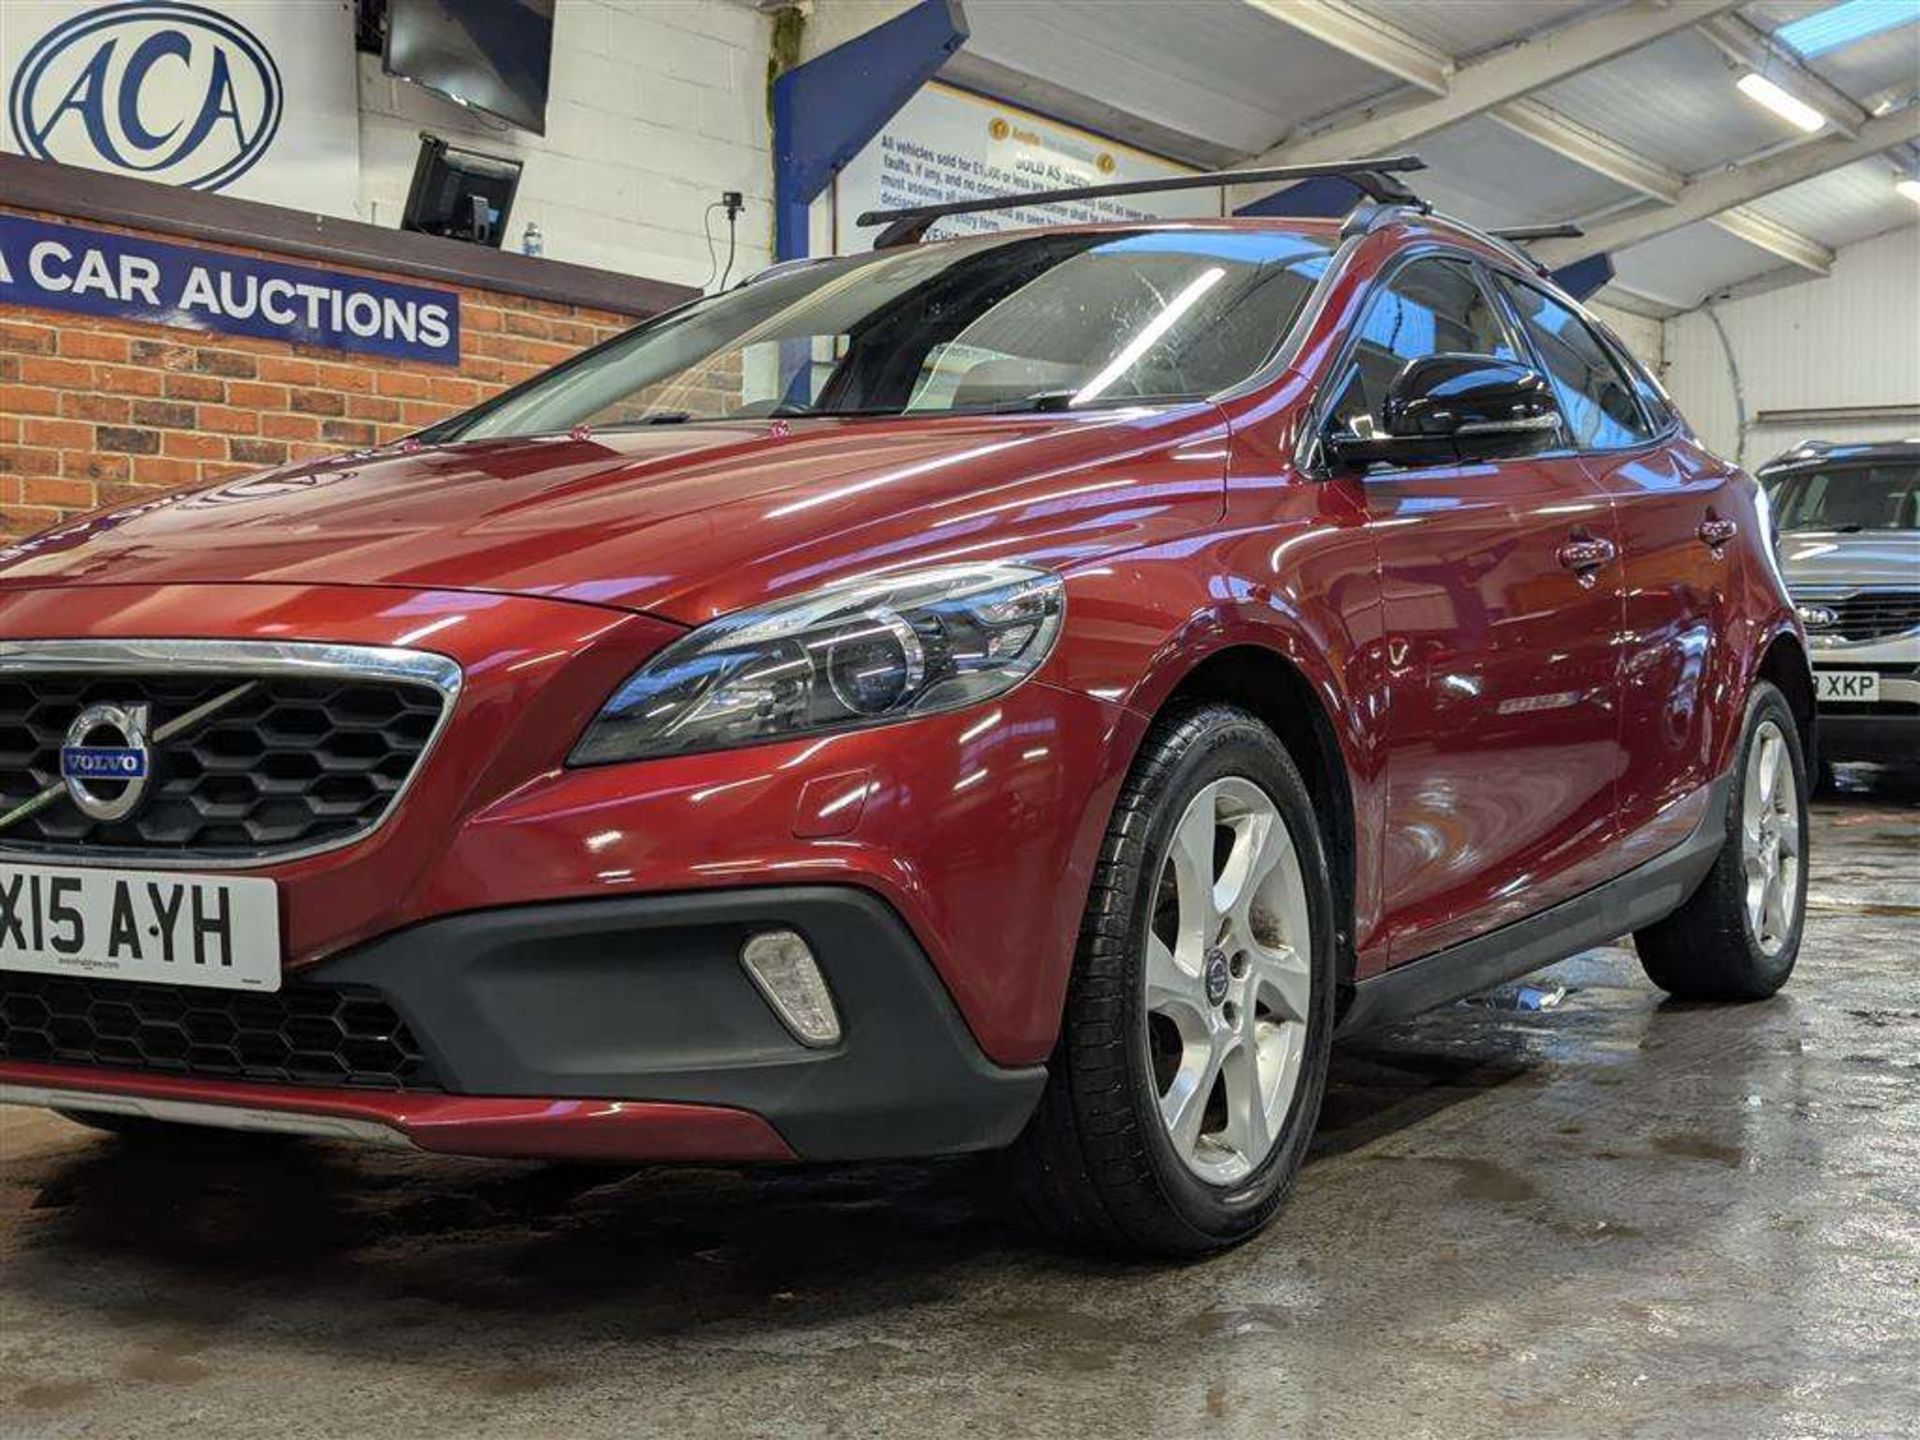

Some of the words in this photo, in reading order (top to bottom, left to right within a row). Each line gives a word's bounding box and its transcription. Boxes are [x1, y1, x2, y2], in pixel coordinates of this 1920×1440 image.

[35, 29, 250, 171] ACA
[29, 241, 161, 305] CAR
[178, 267, 450, 347] AUCTIONS
[1827, 675, 1874, 697] XKP
[68, 754, 138, 771] VOLVO
[108, 880, 232, 966] AYH
